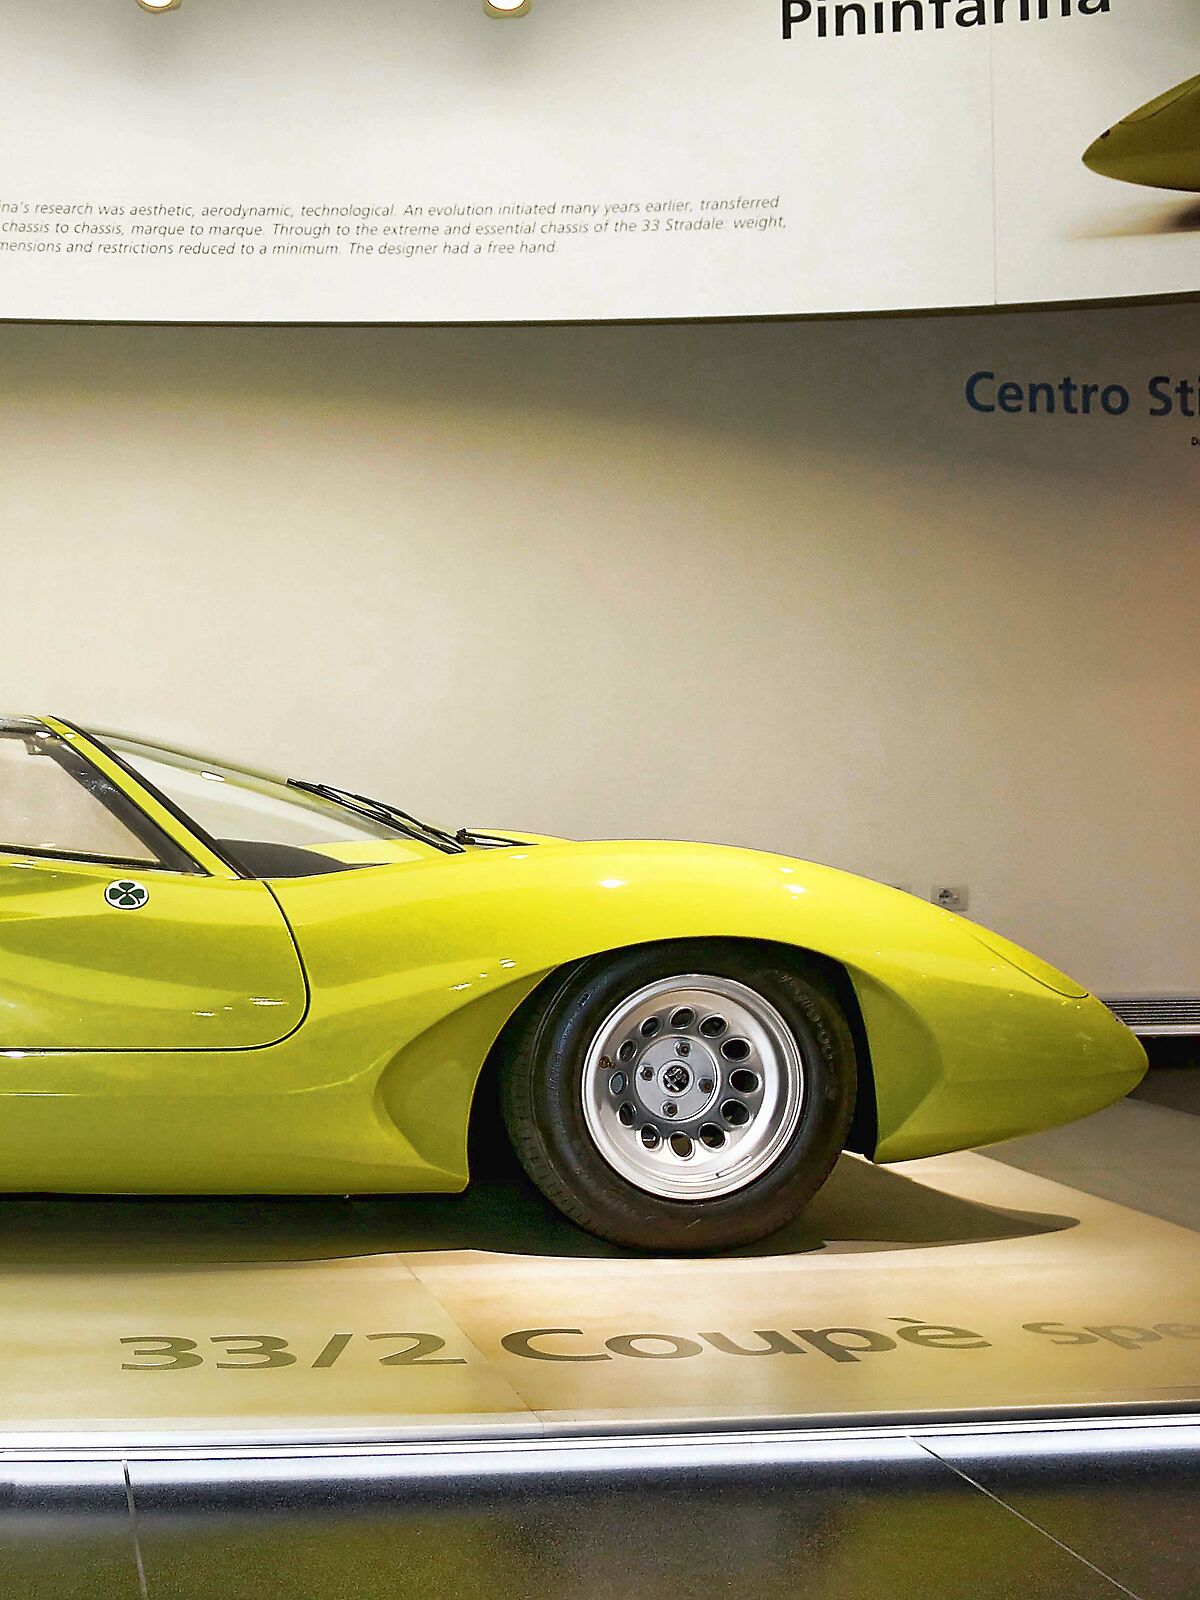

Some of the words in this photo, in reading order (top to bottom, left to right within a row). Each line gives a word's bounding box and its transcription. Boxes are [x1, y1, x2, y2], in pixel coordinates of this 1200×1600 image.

[34, 202, 93, 215] research
[98, 205, 125, 216] was
[129, 203, 195, 218] aesthetic,
[201, 203, 294, 220] aerodynamic,
[403, 204, 423, 216] An
[427, 203, 493, 217] evolution
[498, 202, 557, 216] initiated
[560, 204, 600, 217] many
[604, 203, 641, 217] years
[645, 200, 693, 213] earlier,
[700, 195, 780, 211] transferred
[1, 221, 50, 234] chassis
[55, 222, 70, 234] to
[73, 221, 125, 236] chassis,
[130, 225, 185, 238] marque
[189, 224, 205, 236] to
[272, 223, 331, 240] Through
[336, 225, 351, 236] to
[355, 223, 378, 236] the
[382, 224, 440, 236] extreme
[444, 222, 472, 236] and
[475, 221, 537, 236] essential
[540, 221, 589, 234] chassis
[593, 219, 609, 233] of
[613, 219, 637, 233] the
[641, 218, 660, 232] 33
[733, 215, 786, 232] weight,
[66, 241, 94, 254] and
[97, 241, 174, 255] restrictions
[178, 241, 236, 255] reduced
[240, 243, 255, 255] to
[258, 245, 268, 255] a
[349, 242, 374, 256] The
[377, 241, 439, 258] designer
[442, 240, 470, 255] had
[473, 244, 482, 255] a
[487, 240, 515, 254] free
[965, 371, 1130, 415] Centro
[1148, 376, 1200, 416] St
[119, 1332, 468, 1371] 33/2
[500, 1316, 993, 1363] Coupè
